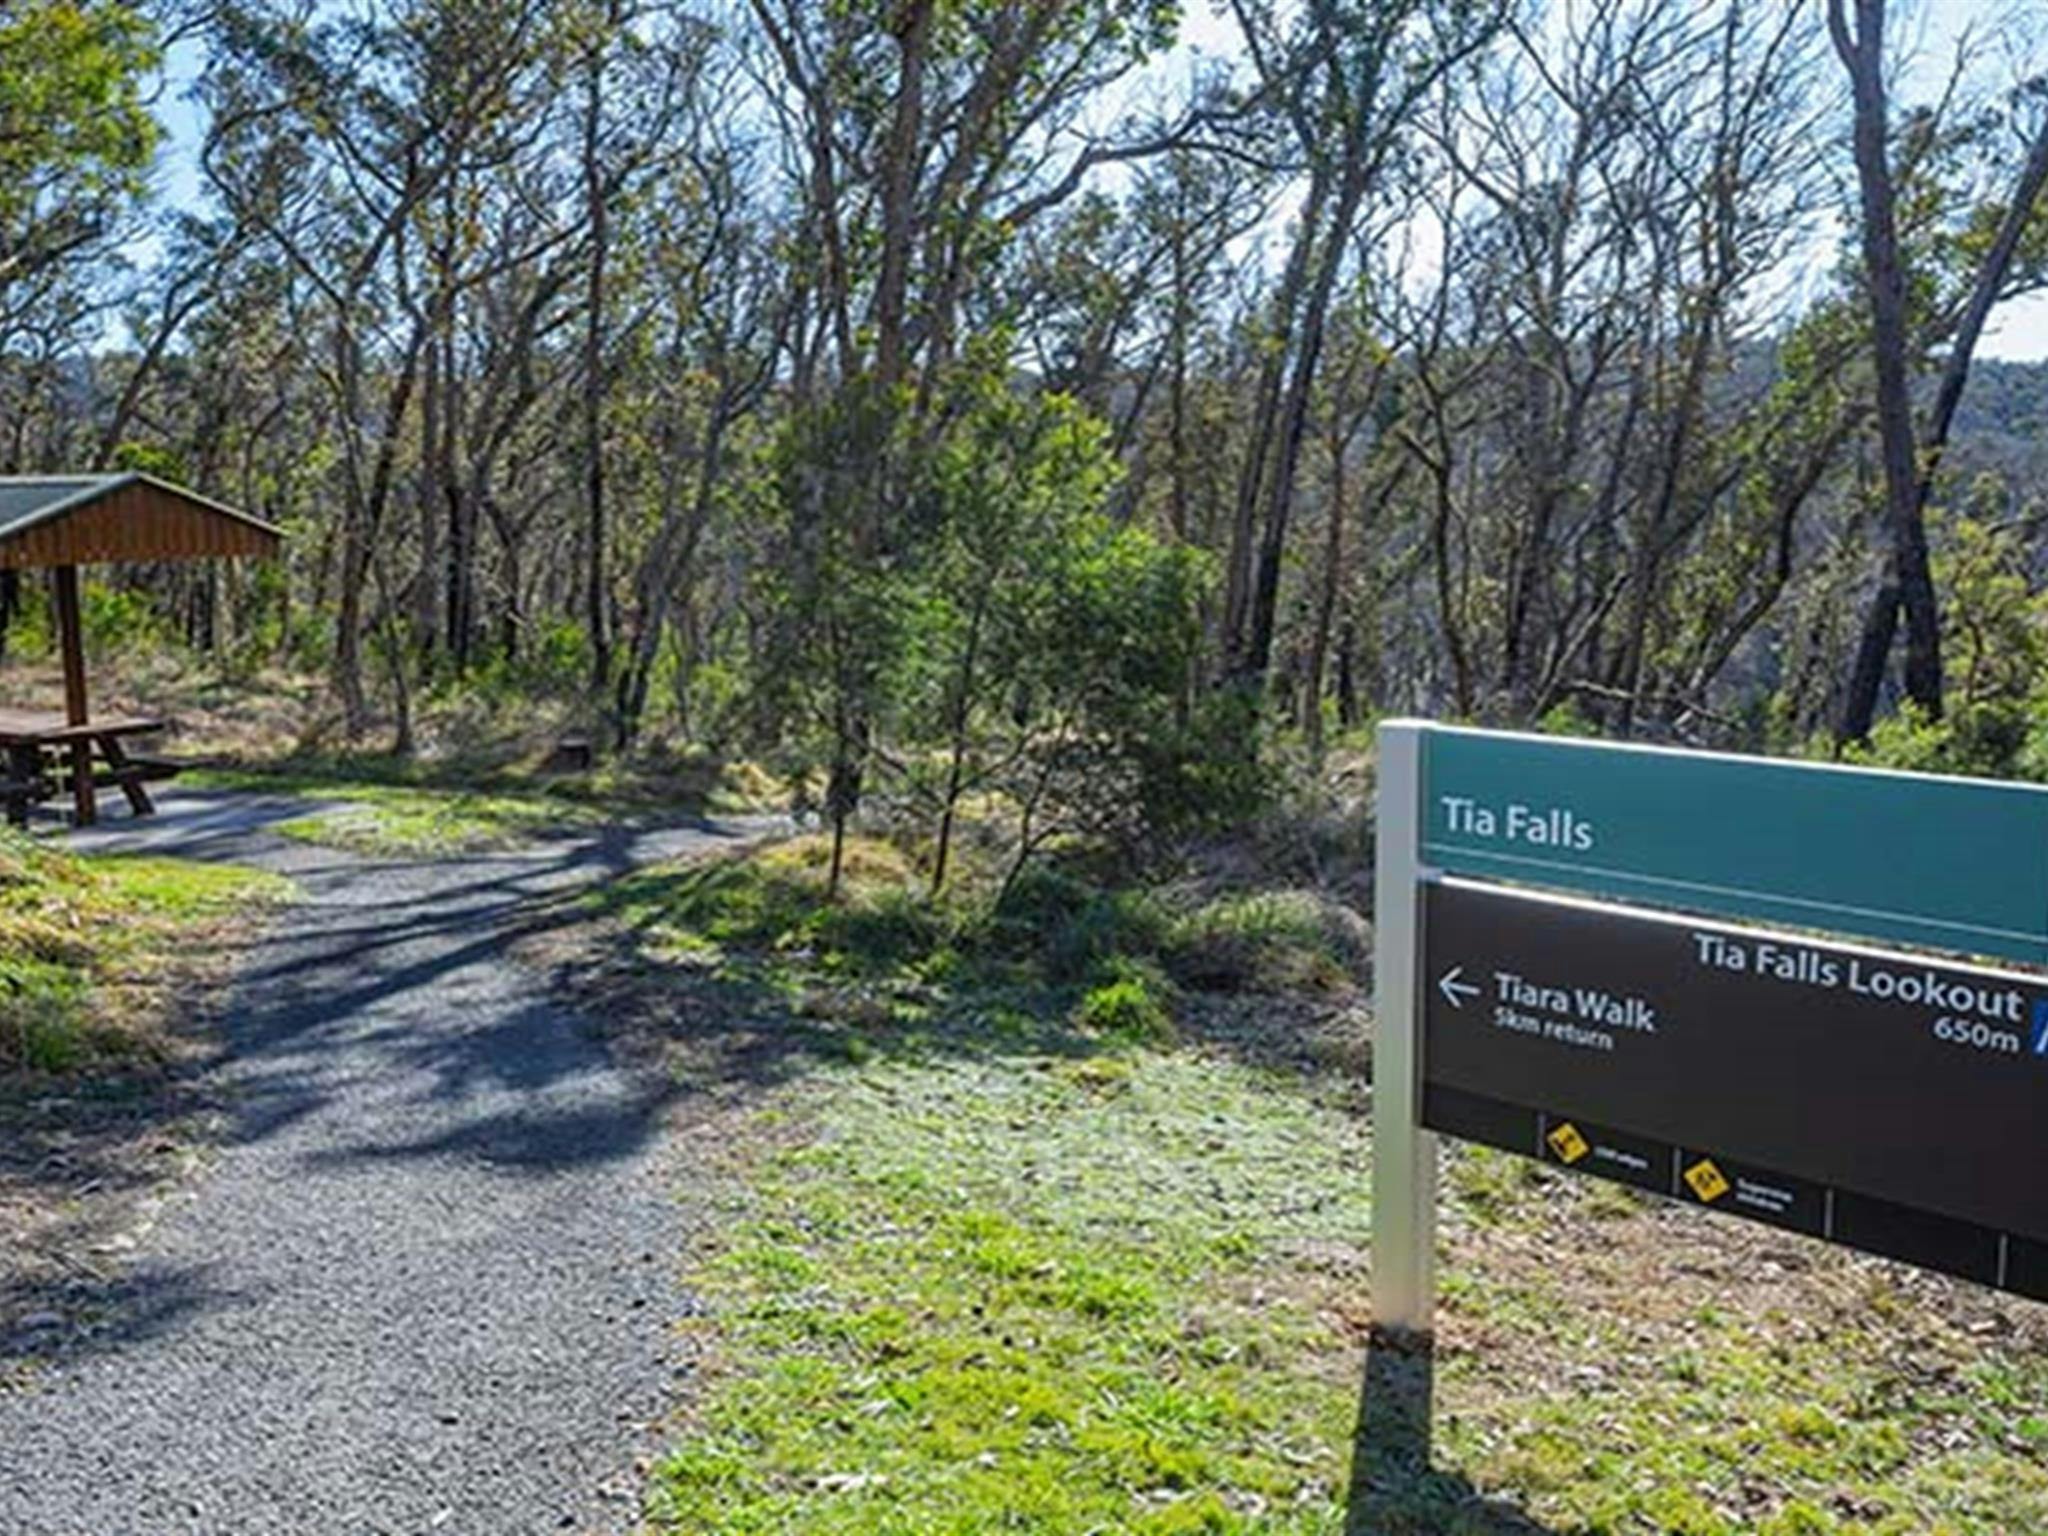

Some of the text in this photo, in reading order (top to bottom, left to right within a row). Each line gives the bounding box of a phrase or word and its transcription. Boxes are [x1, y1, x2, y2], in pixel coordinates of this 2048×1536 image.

[1440, 795, 1594, 849] Tia Falls
[1494, 971, 1657, 1033] Tiara Walk
[1692, 931, 2024, 1022] Tia Falls Lookout
[1543, 1021, 1614, 1051] return
[1933, 1016, 2020, 1053] 650m
